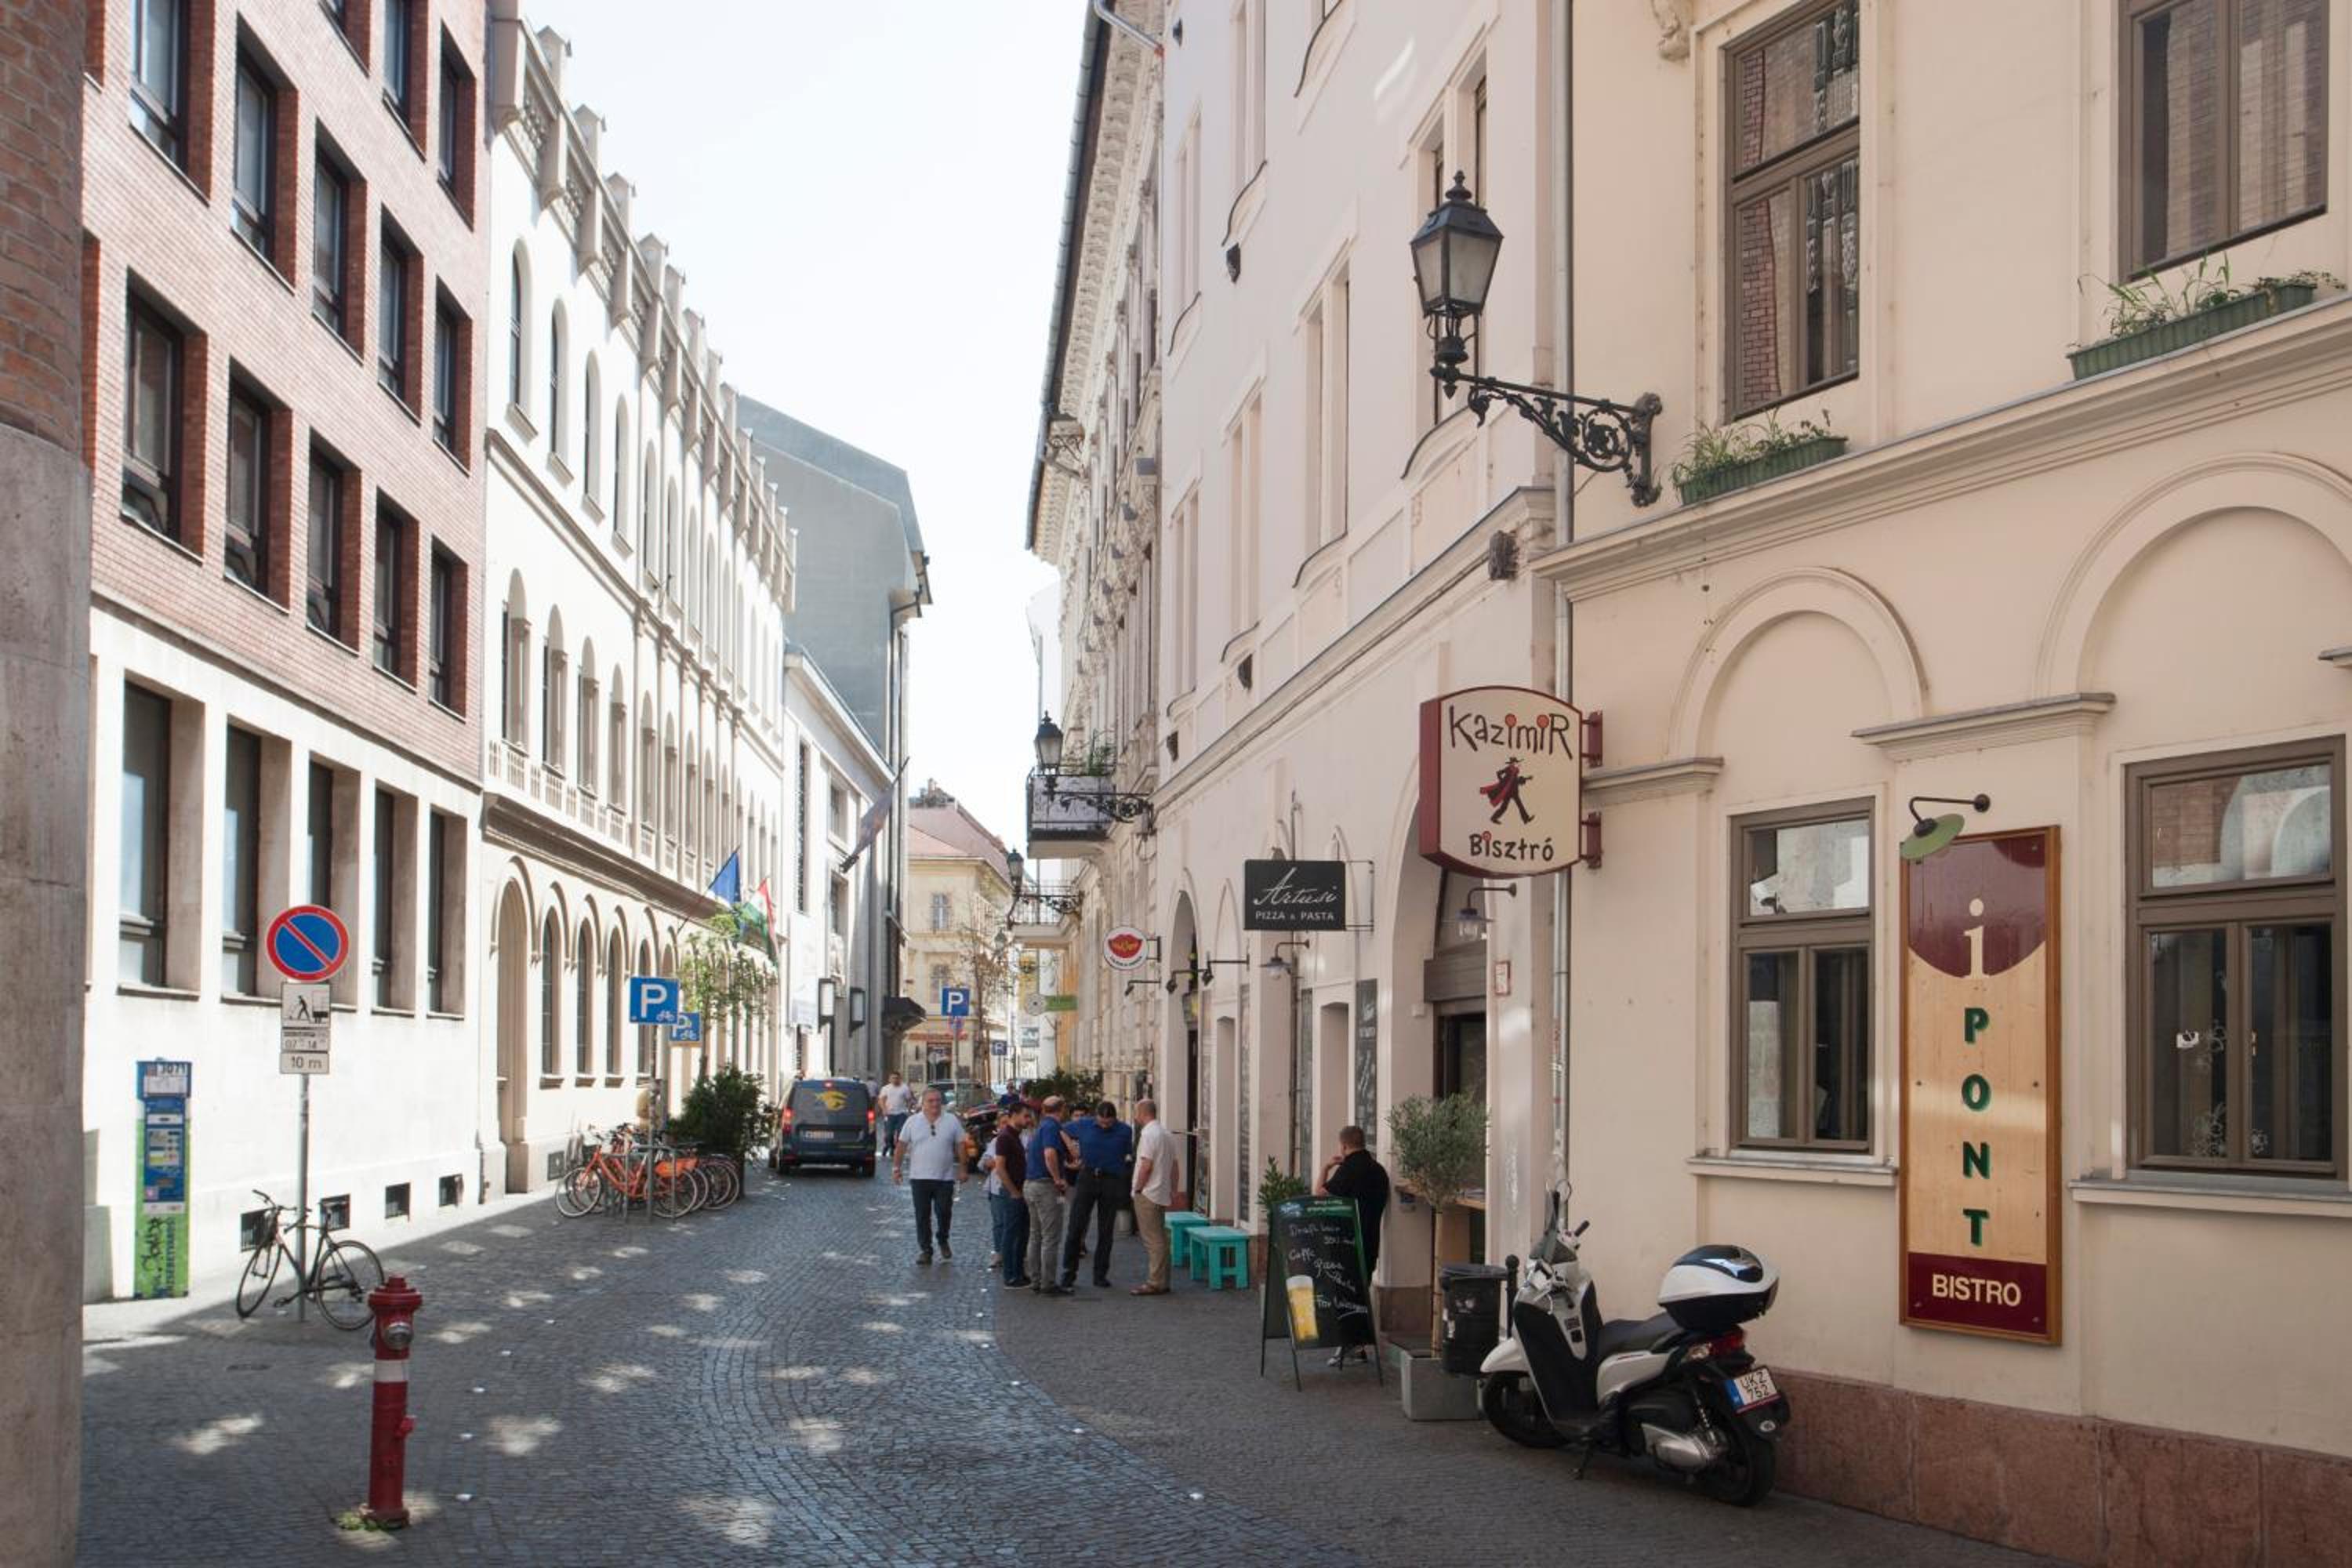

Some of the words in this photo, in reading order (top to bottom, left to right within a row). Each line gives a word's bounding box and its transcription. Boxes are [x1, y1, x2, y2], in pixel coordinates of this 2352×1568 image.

[1254, 867, 1338, 906] Artusi
[1255, 910, 1285, 920] PIZZA
[1301, 911, 1334, 921] PASTA
[641, 983, 668, 1018] P
[948, 992, 964, 1013] P
[291, 1056, 304, 1069] 10
[308, 1058, 323, 1069] m
[1932, 1274, 2022, 1307] BISTRO
